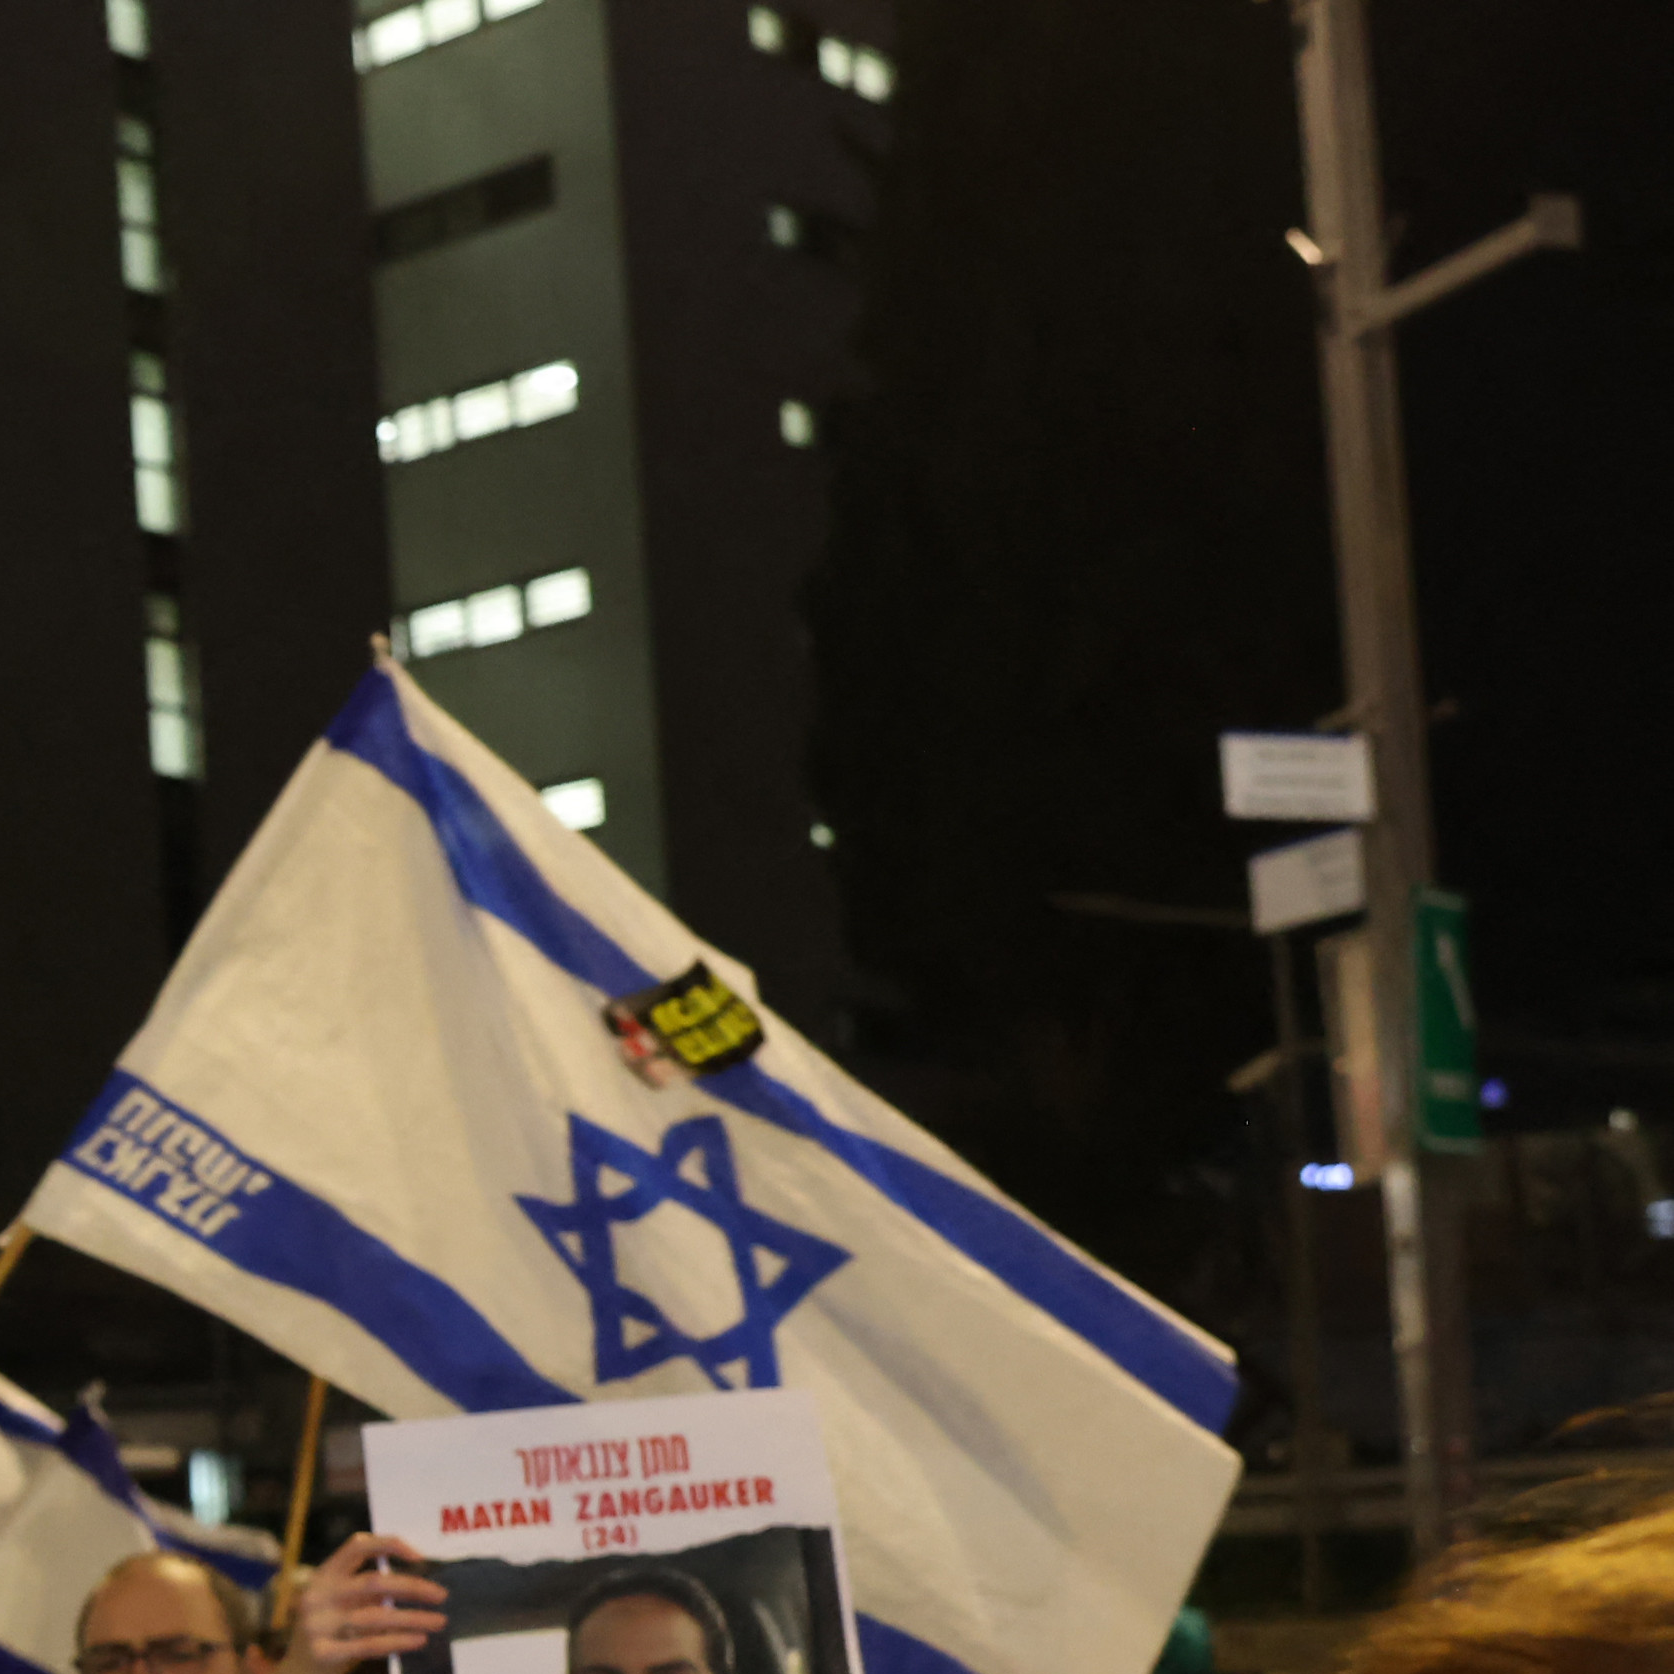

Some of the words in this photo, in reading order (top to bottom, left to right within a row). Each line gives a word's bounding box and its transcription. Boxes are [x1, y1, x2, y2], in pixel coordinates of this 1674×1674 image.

[638, 1434, 690, 1479] מתן
[440, 1498, 551, 1534] MATAN
[575, 1476, 774, 1521] ZANGAUKER
[581, 1523, 638, 1551] (24)
